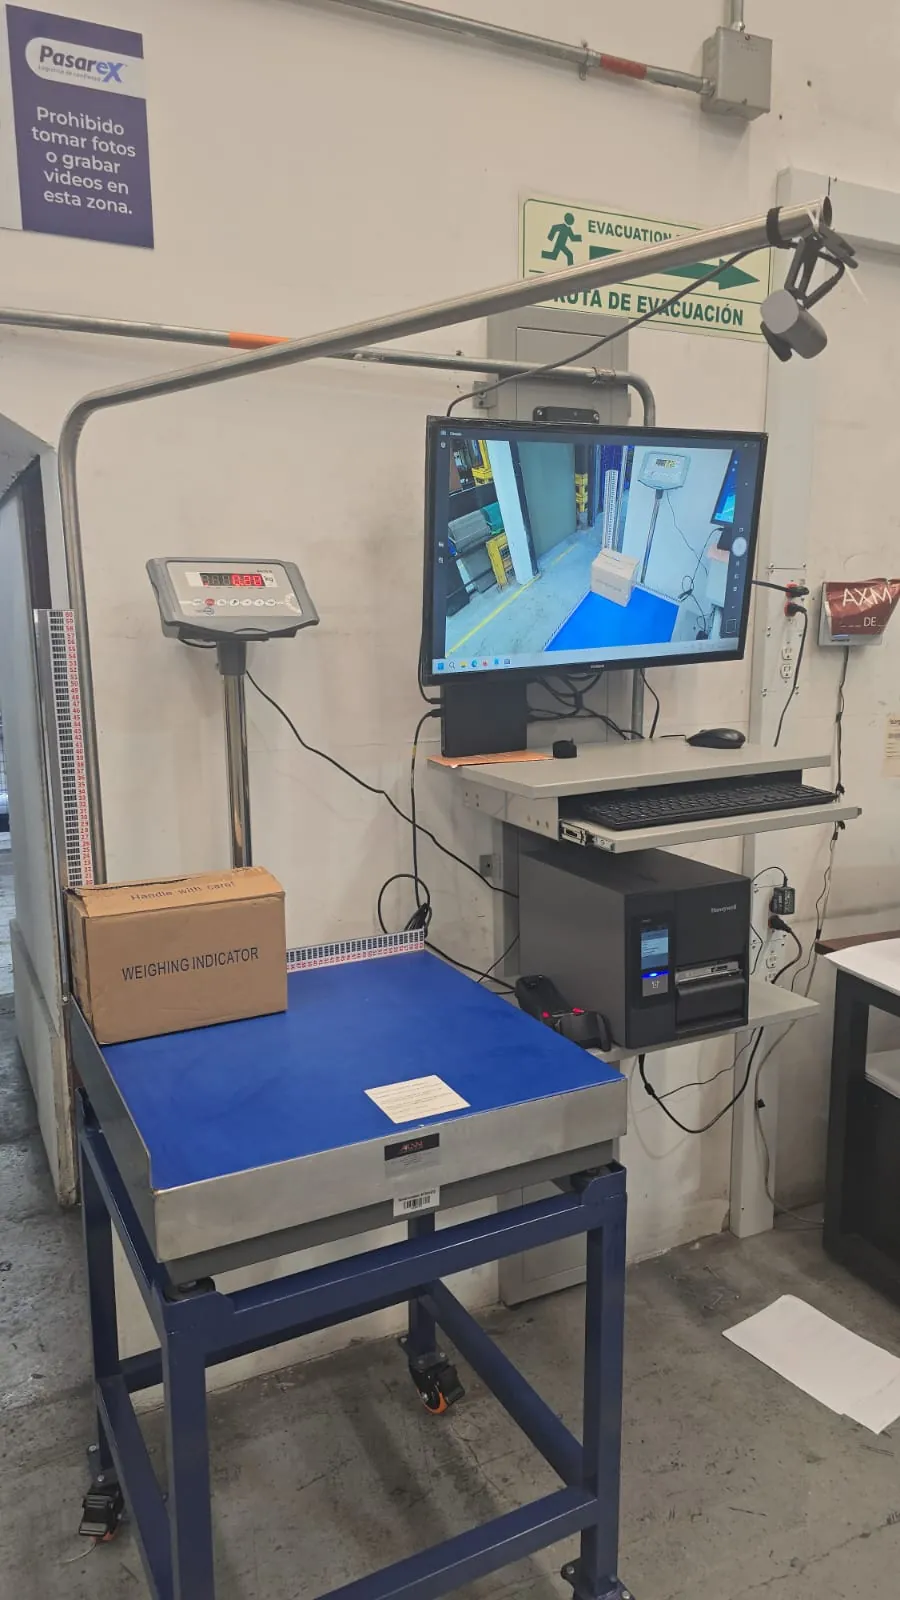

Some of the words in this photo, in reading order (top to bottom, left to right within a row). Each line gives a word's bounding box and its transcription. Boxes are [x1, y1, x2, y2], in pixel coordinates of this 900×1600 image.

[36, 106, 124, 136] Prohibido
[31, 126, 87, 149] tomar
[91, 135, 136, 158] fotos
[45, 151, 57, 163] o
[62, 153, 120, 174] grabar
[43, 167, 103, 190] videos
[107, 180, 128, 195] en
[43, 190, 82, 207] esta
[85, 196, 132, 214] zona.
[588, 219, 672, 242] EVACUATION
[608, 291, 631, 312] DE
[637, 295, 743, 326] EVACUACIÓN
[863, 616, 877, 627] DE
[122, 957, 190, 981] WEIGHING
[192, 947, 259, 970] INDICATOR
